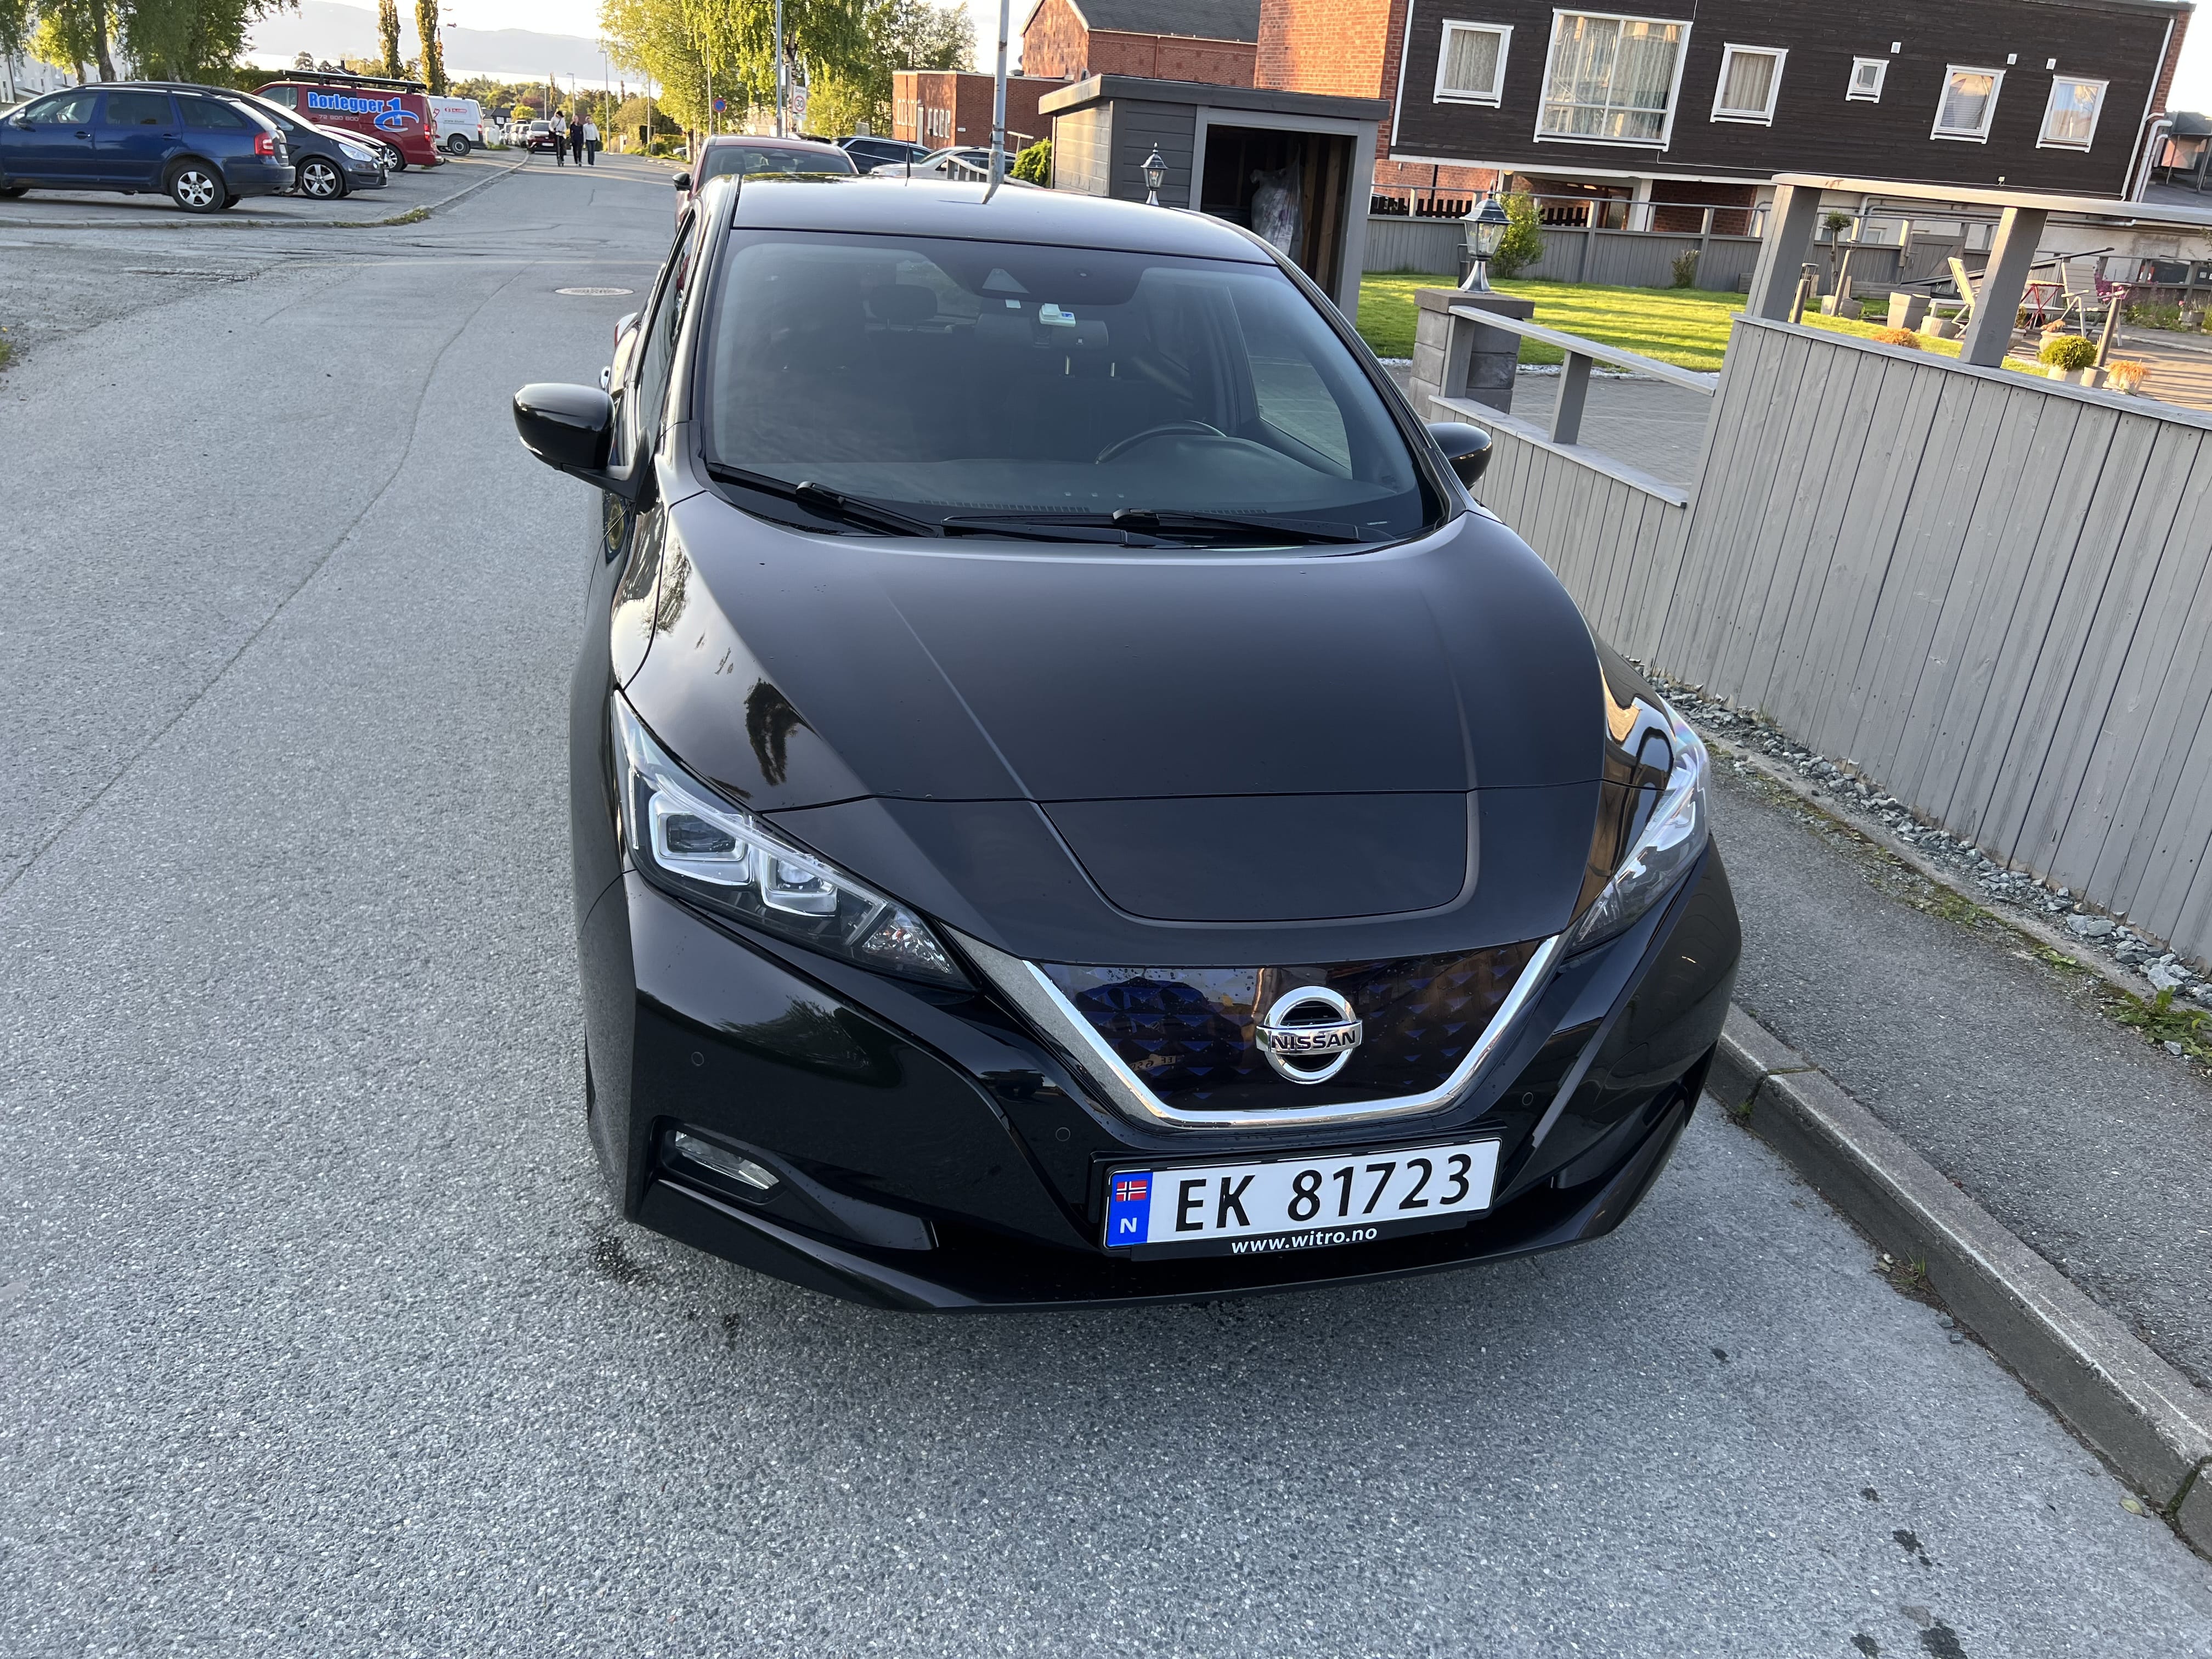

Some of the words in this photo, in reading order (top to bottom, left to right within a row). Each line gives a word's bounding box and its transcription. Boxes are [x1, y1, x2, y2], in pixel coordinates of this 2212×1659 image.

[796, 99, 804, 108] 30
[1271, 1030, 1355, 1049] NISSAN
[1176, 1175, 1255, 1232] EK
[1287, 1153, 1472, 1221] 81723
[1120, 1217, 1137, 1234] N
[1231, 1227, 1378, 1254] www.witro.no
